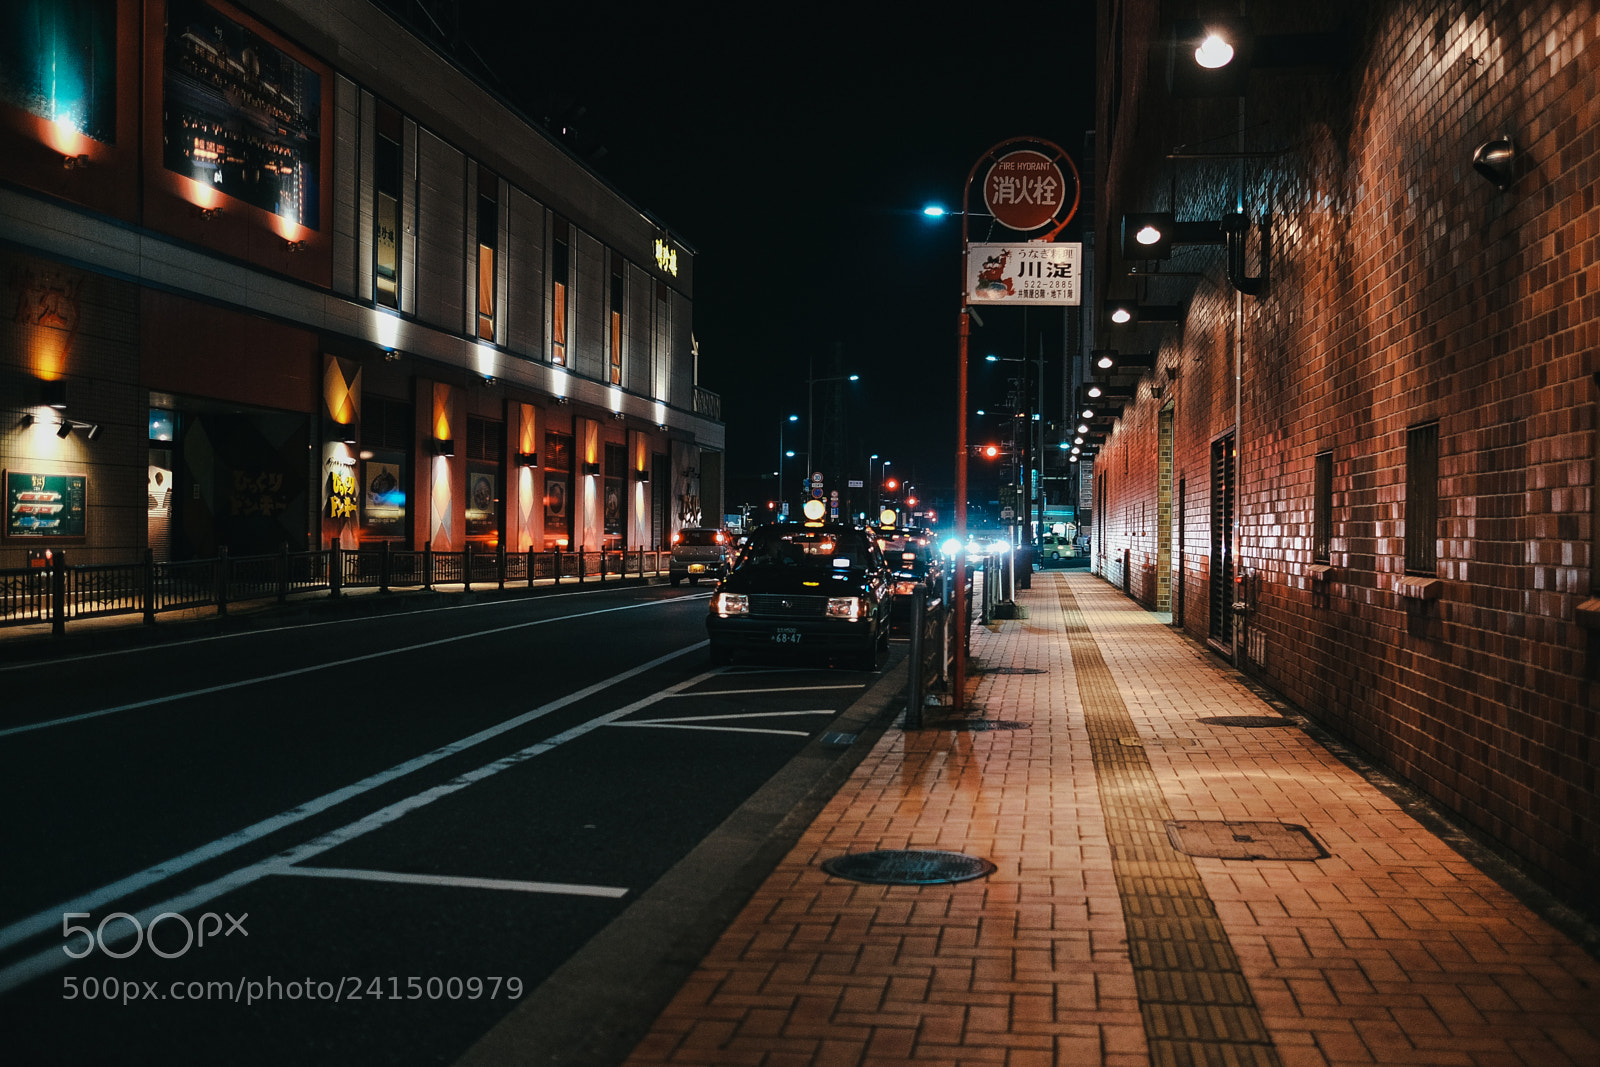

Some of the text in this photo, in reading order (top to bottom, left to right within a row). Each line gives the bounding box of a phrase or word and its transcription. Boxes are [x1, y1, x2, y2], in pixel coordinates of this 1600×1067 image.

[998, 162, 1051, 171] FIRE HYDRANT
[992, 175, 1058, 206] 消火栓
[1017, 261, 1073, 279] 川淀
[1024, 280, 1073, 289] 522-2885
